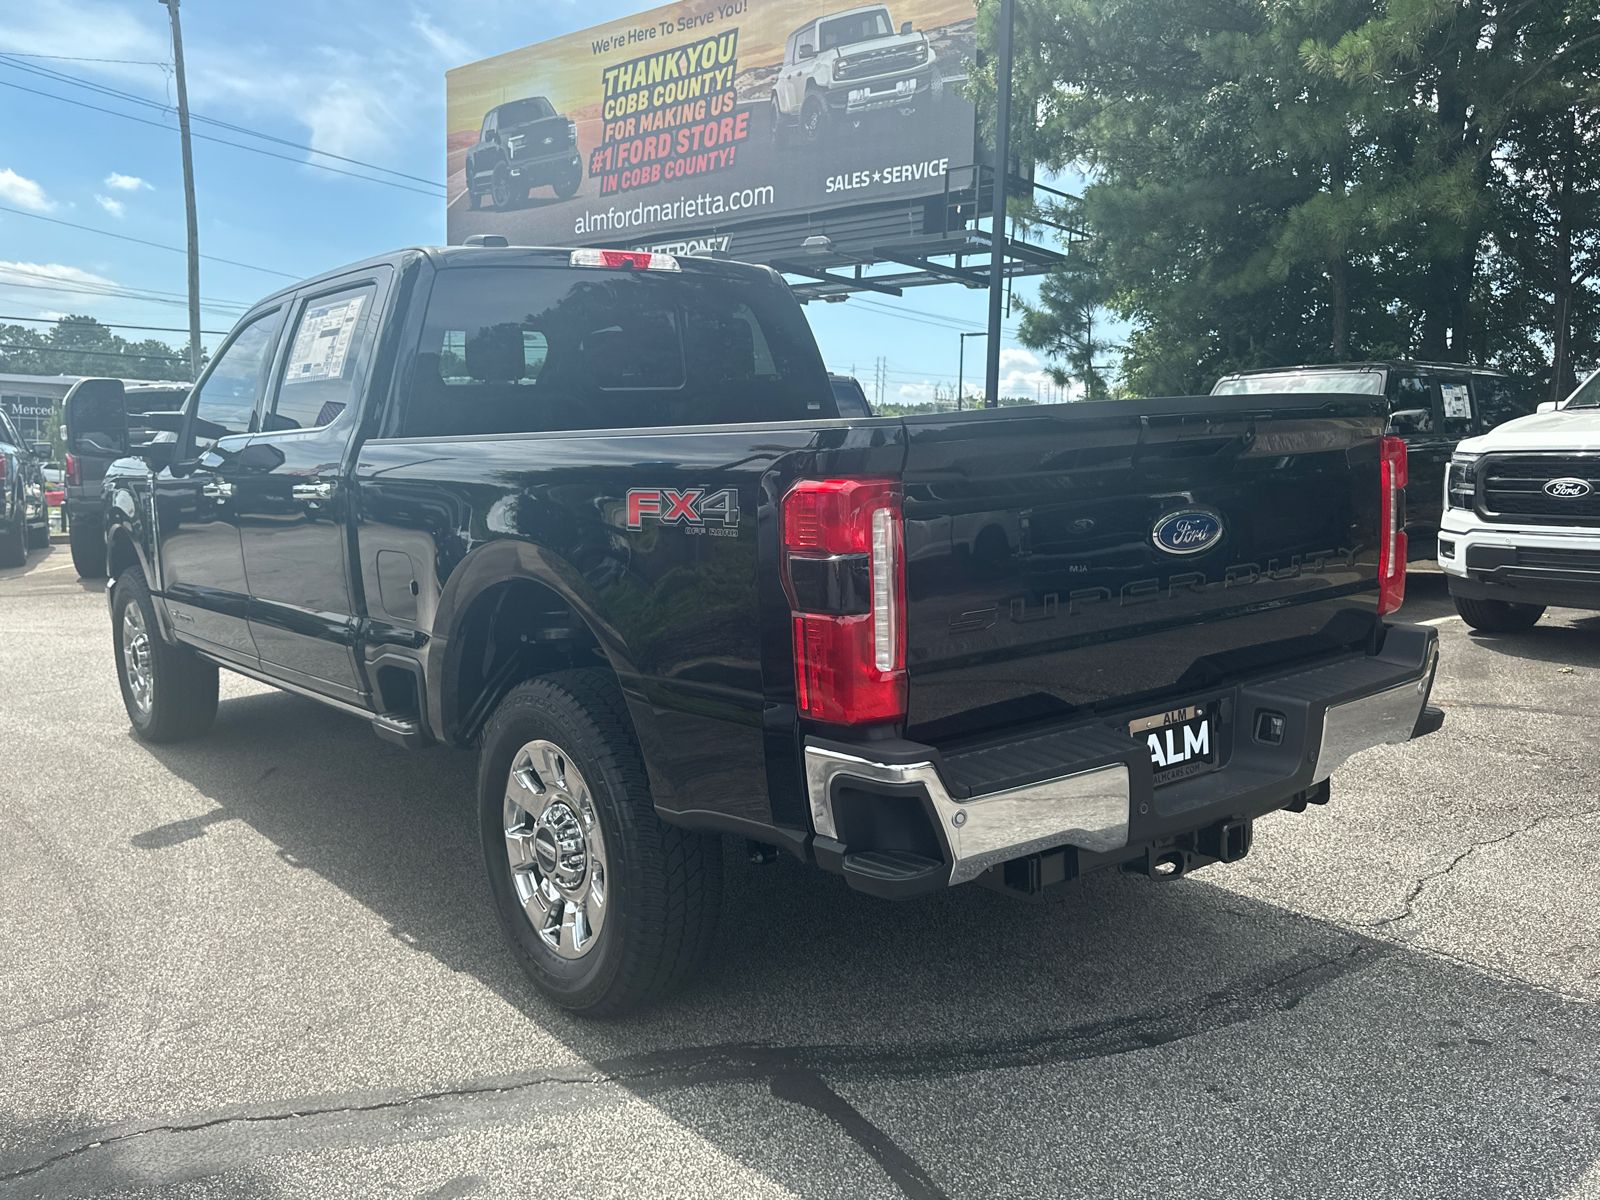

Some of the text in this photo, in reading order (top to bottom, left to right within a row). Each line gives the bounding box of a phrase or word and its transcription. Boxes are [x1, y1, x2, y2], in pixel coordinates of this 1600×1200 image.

[592, 0, 748, 54] We're Here To Serve You!
[604, 33, 735, 97] THANK YOU
[604, 65, 734, 120] COBB COUNTY!
[604, 91, 735, 144] FOR MAKING US
[591, 112, 749, 174] #1 FORD STORE
[602, 146, 736, 193] IN COBB COUNTY!
[825, 158, 949, 193] SALES SERVICE
[574, 185, 774, 234] almfordmarietta.com
[12, 403, 57, 416] Merced
[626, 487, 740, 532] FX4
[1552, 482, 1581, 495] Ford
[1172, 519, 1209, 545] Ford
[949, 543, 1364, 636] SUPER DUTY
[1163, 708, 1187, 726] ALM
[1147, 720, 1209, 767] ALM
